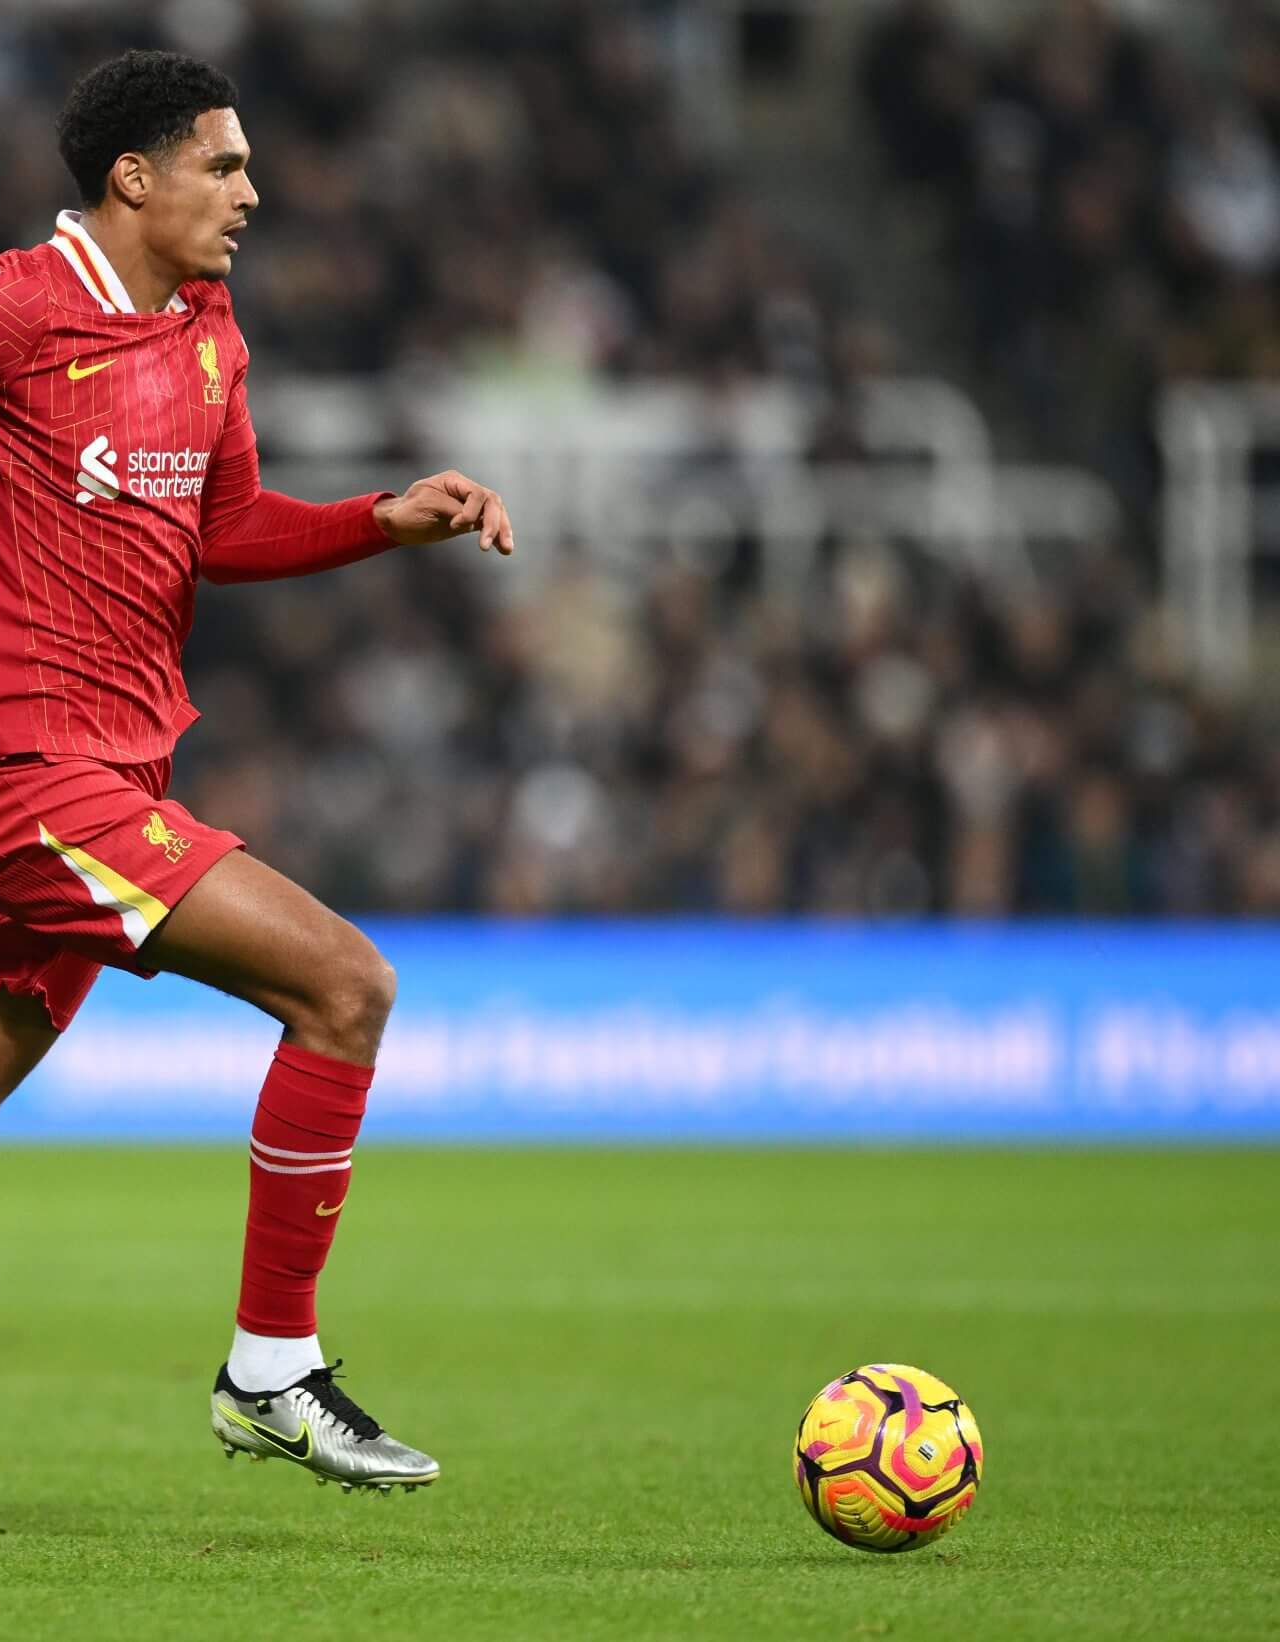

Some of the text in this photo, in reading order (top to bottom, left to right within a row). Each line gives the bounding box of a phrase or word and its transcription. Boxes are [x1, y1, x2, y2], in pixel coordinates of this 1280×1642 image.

[204, 389, 224, 404] LFC
[128, 473, 205, 498] chartere
[166, 838, 192, 864] LFC
